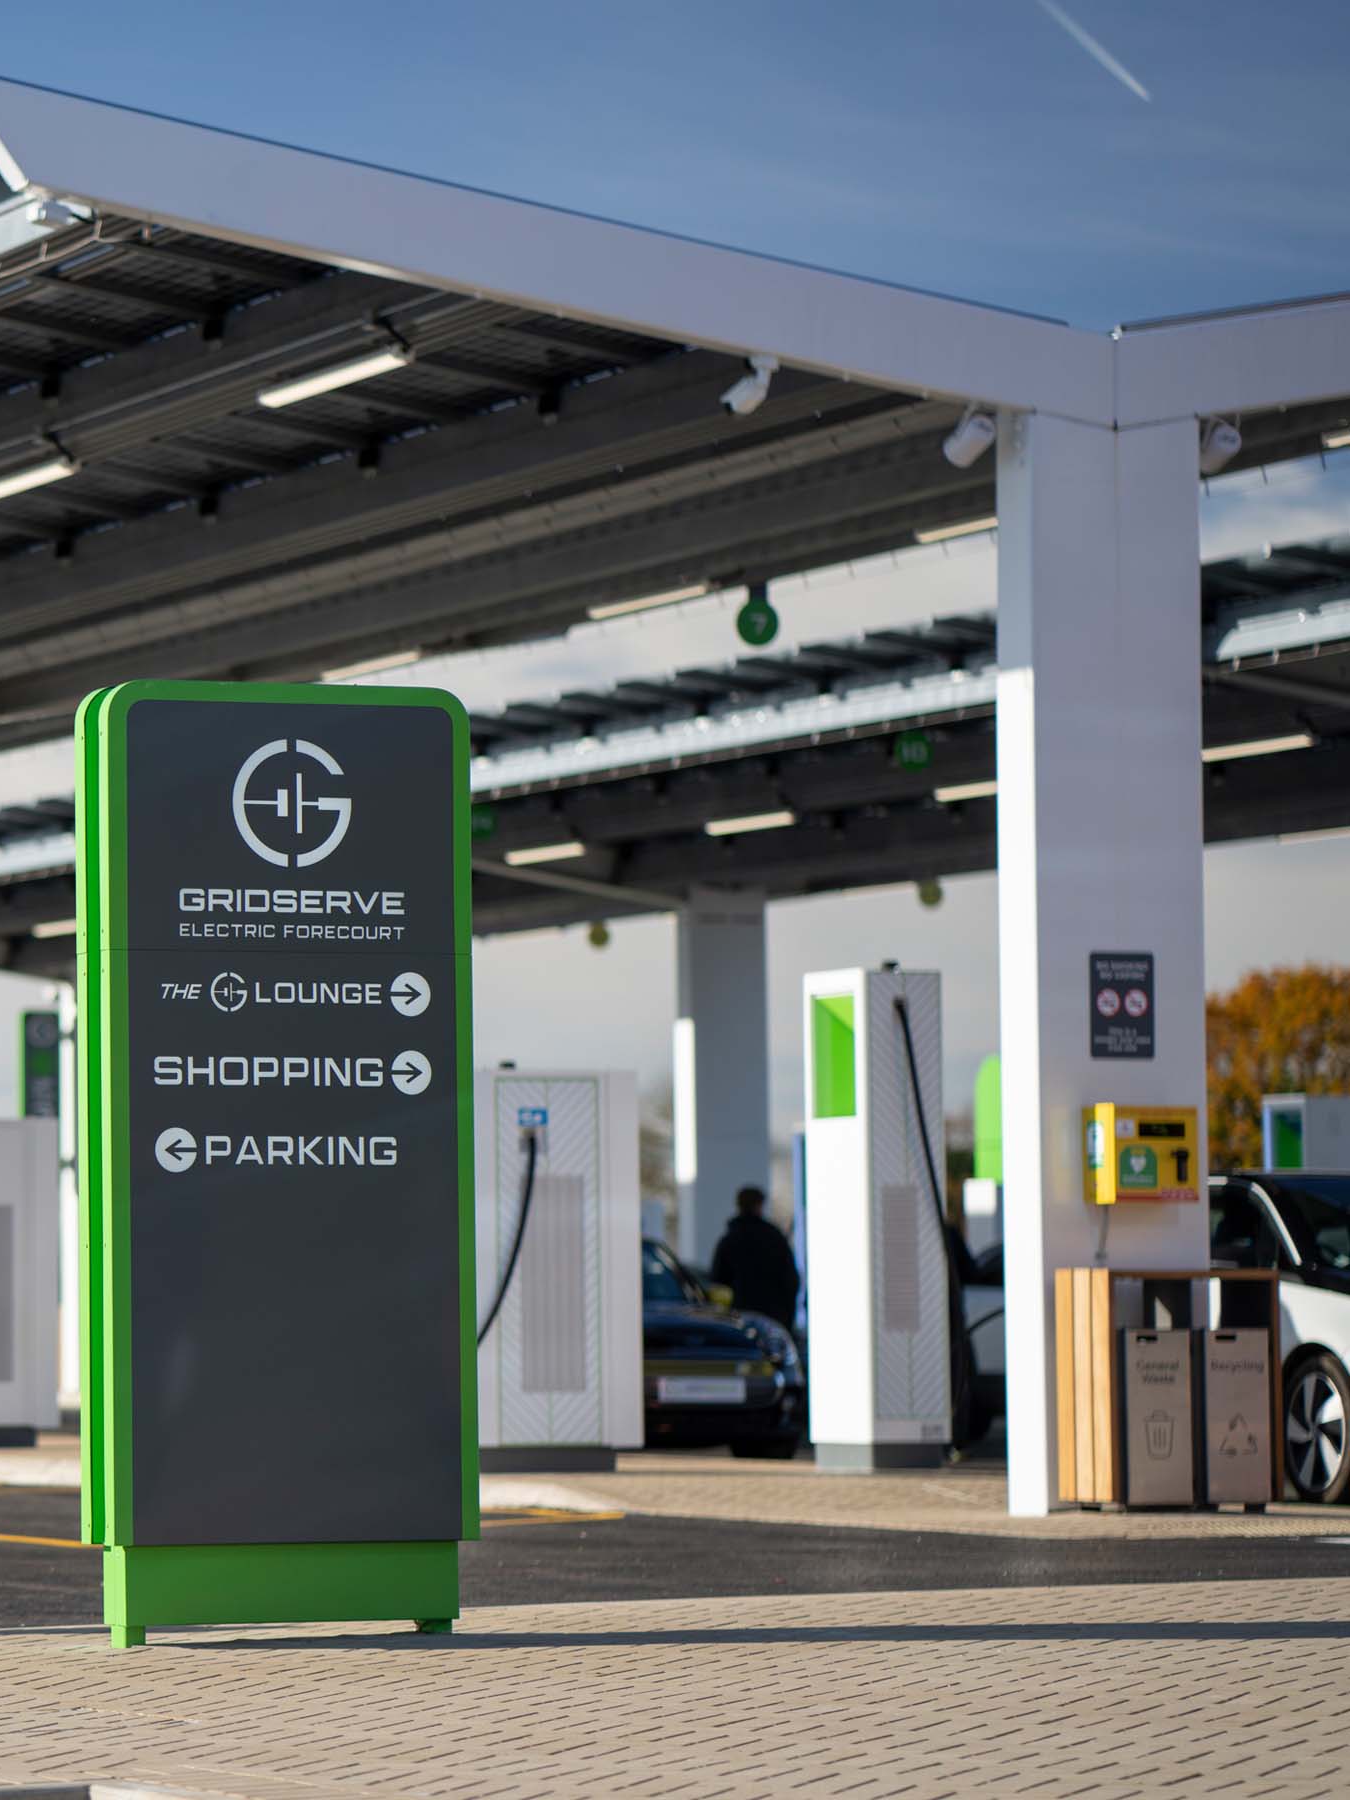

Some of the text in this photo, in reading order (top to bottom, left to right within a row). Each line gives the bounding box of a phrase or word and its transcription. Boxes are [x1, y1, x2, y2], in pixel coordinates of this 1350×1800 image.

[179, 887, 405, 916] GRIDSERVE
[179, 923, 405, 940] ELECTRIC FORECOURT
[161, 983, 203, 1000] THE
[255, 981, 382, 1005] LOUNGE
[153, 1055, 384, 1087] SHOPPING
[205, 1135, 398, 1166] PARKING
